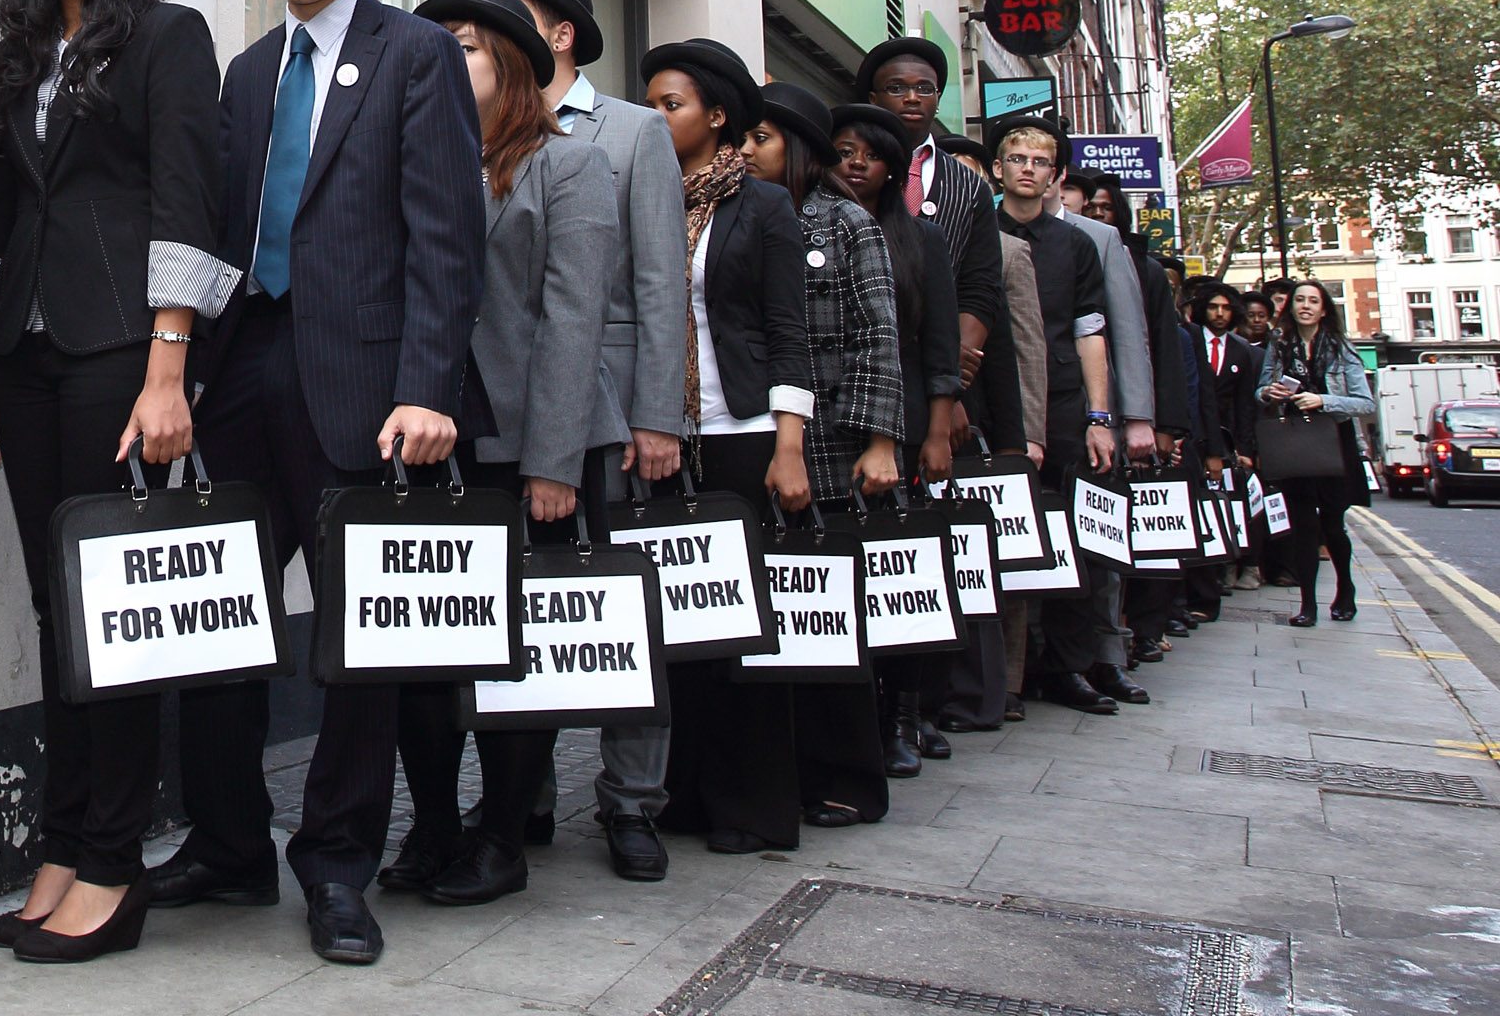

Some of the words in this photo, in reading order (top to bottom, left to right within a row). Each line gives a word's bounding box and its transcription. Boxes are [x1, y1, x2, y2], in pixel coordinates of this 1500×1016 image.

[998, 11, 1063, 33] BAR
[1006, 92, 1029, 107] Bar
[1081, 155, 1144, 170] repairs
[1083, 144, 1140, 158] Guitar
[1140, 209, 1172, 220] BAR
[1085, 490, 1116, 516] READY
[1132, 489, 1169, 506] EADY
[1079, 514, 1097, 534] FOR
[1098, 521, 1125, 544] WORK
[1142, 515, 1187, 532] WORK
[123, 539, 225, 585] READY
[382, 540, 473, 573] READY
[626, 535, 712, 568] EADY
[864, 549, 917, 577] EADY
[956, 569, 987, 590] ORK
[665, 579, 744, 611] WORK
[883, 589, 942, 616] WORK
[101, 606, 164, 644] FOR
[170, 594, 259, 636] WORK
[359, 596, 410, 628] FOR
[417, 595, 497, 627] WORK
[790, 611, 848, 635] WORK
[549, 642, 638, 673] WORK
